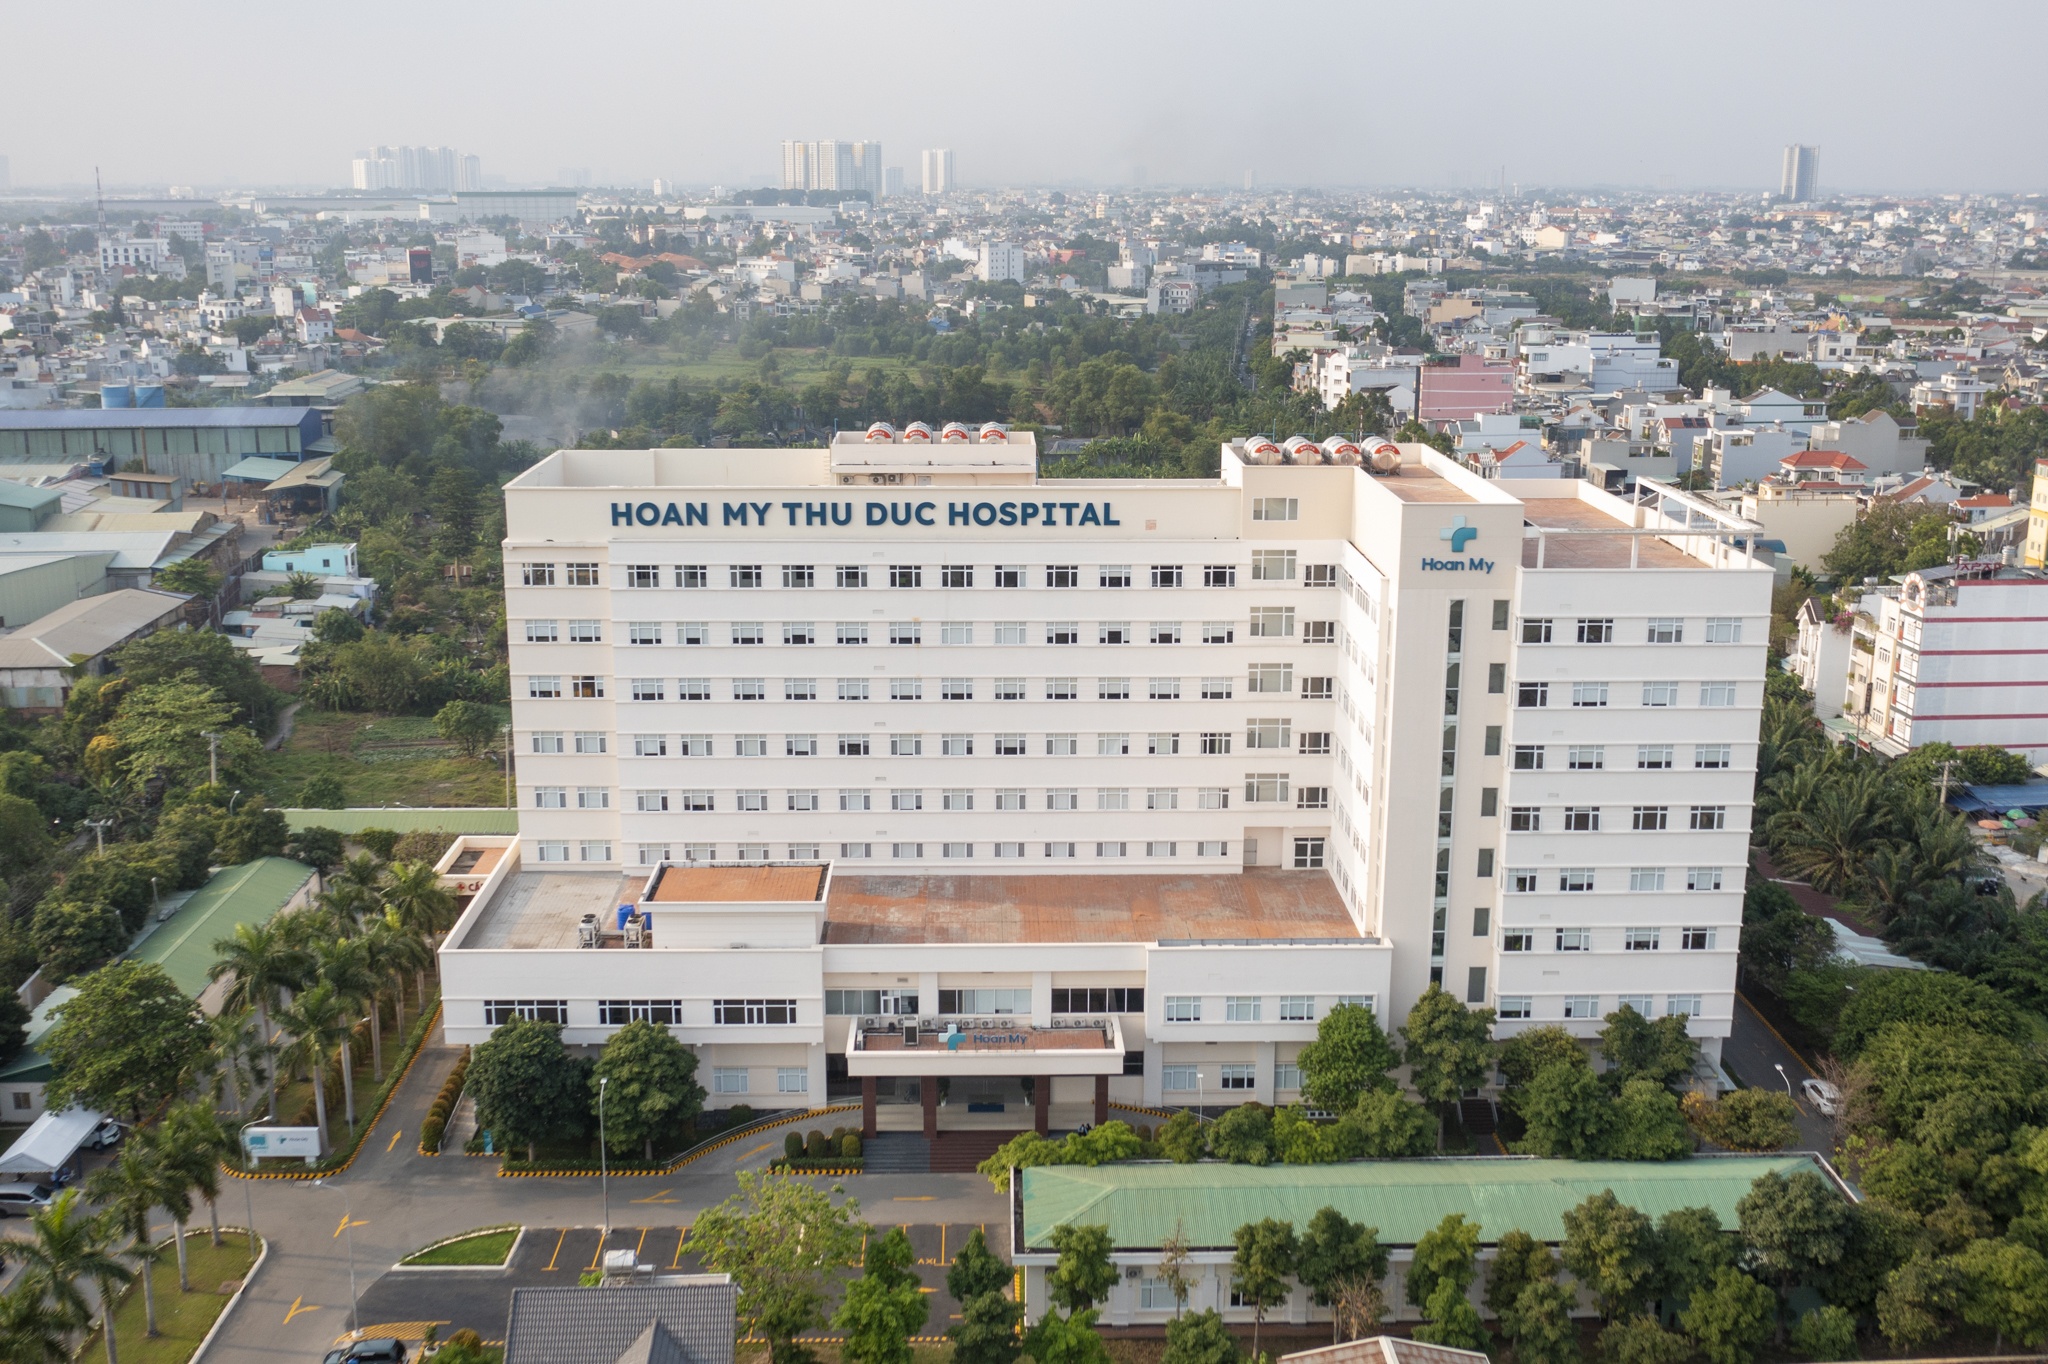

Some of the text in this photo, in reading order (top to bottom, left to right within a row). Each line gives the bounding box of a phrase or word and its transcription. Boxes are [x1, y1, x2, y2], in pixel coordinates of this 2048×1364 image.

[611, 502, 1120, 527] HOAN MY THU DUC HOSPITAL
[1421, 558, 1495, 575] Hoan My
[973, 1033, 1027, 1045] Hoan My
